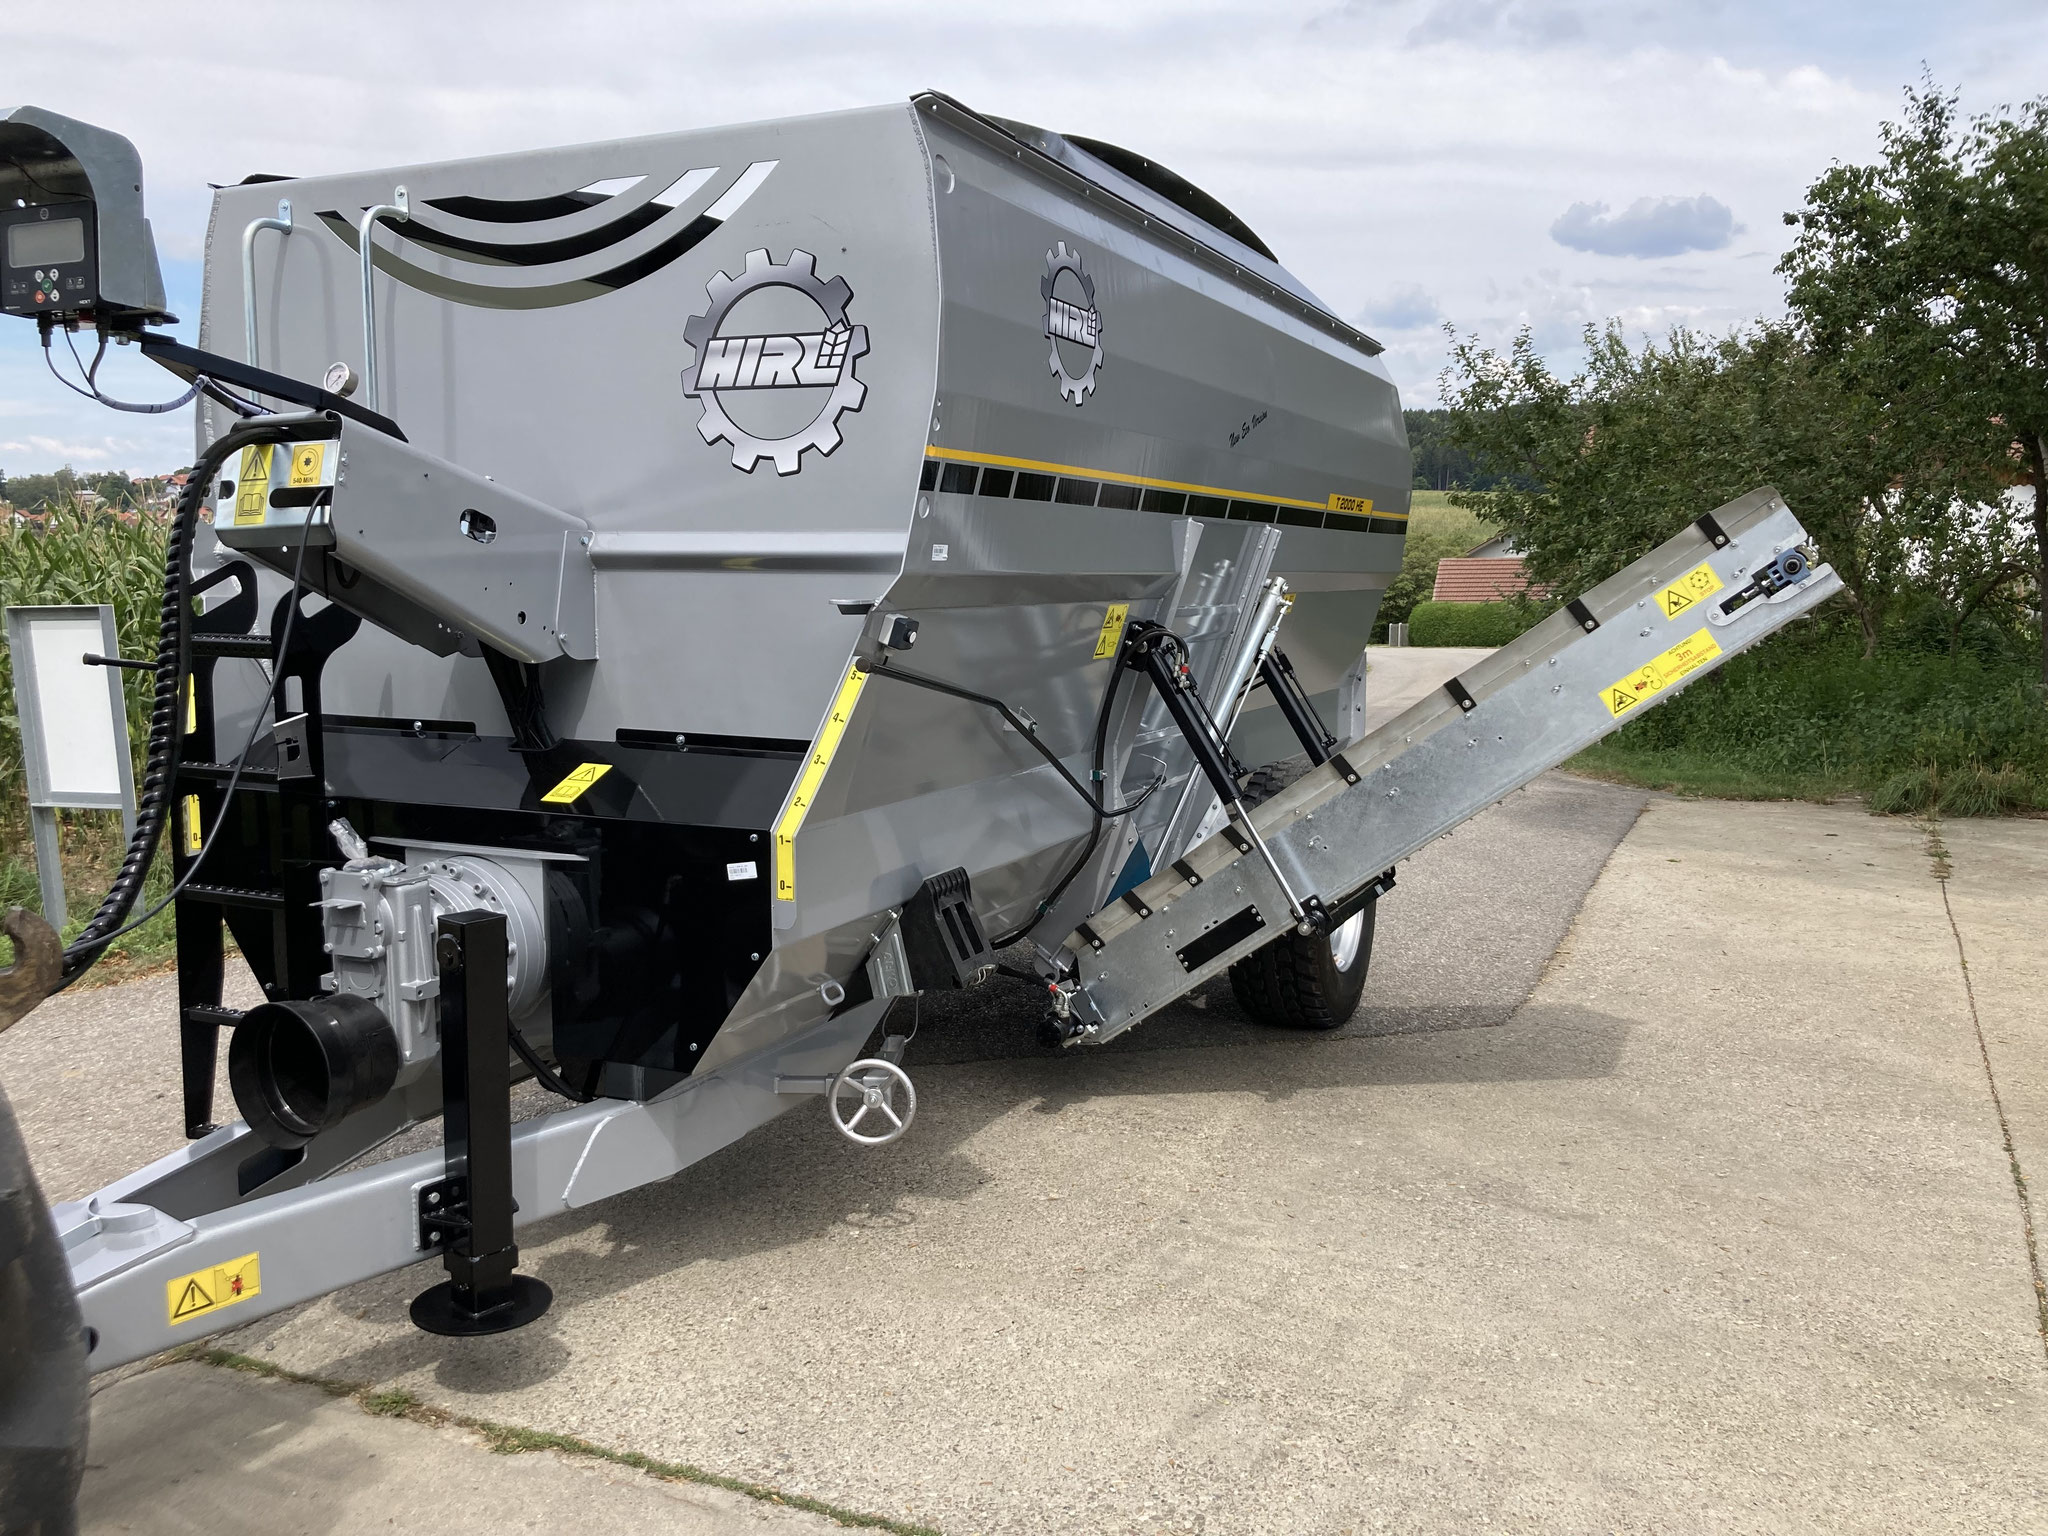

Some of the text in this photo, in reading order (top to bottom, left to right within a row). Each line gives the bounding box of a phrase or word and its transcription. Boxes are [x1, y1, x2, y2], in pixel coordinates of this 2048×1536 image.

[1049, 297, 1097, 349] HIRL
[696, 331, 854, 390] HIRL
[1339, 497, 1356, 511] 2000
[1355, 500, 1365, 513] HE
[1699, 584, 1715, 597] STOP
[1675, 649, 1693, 662] 3m
